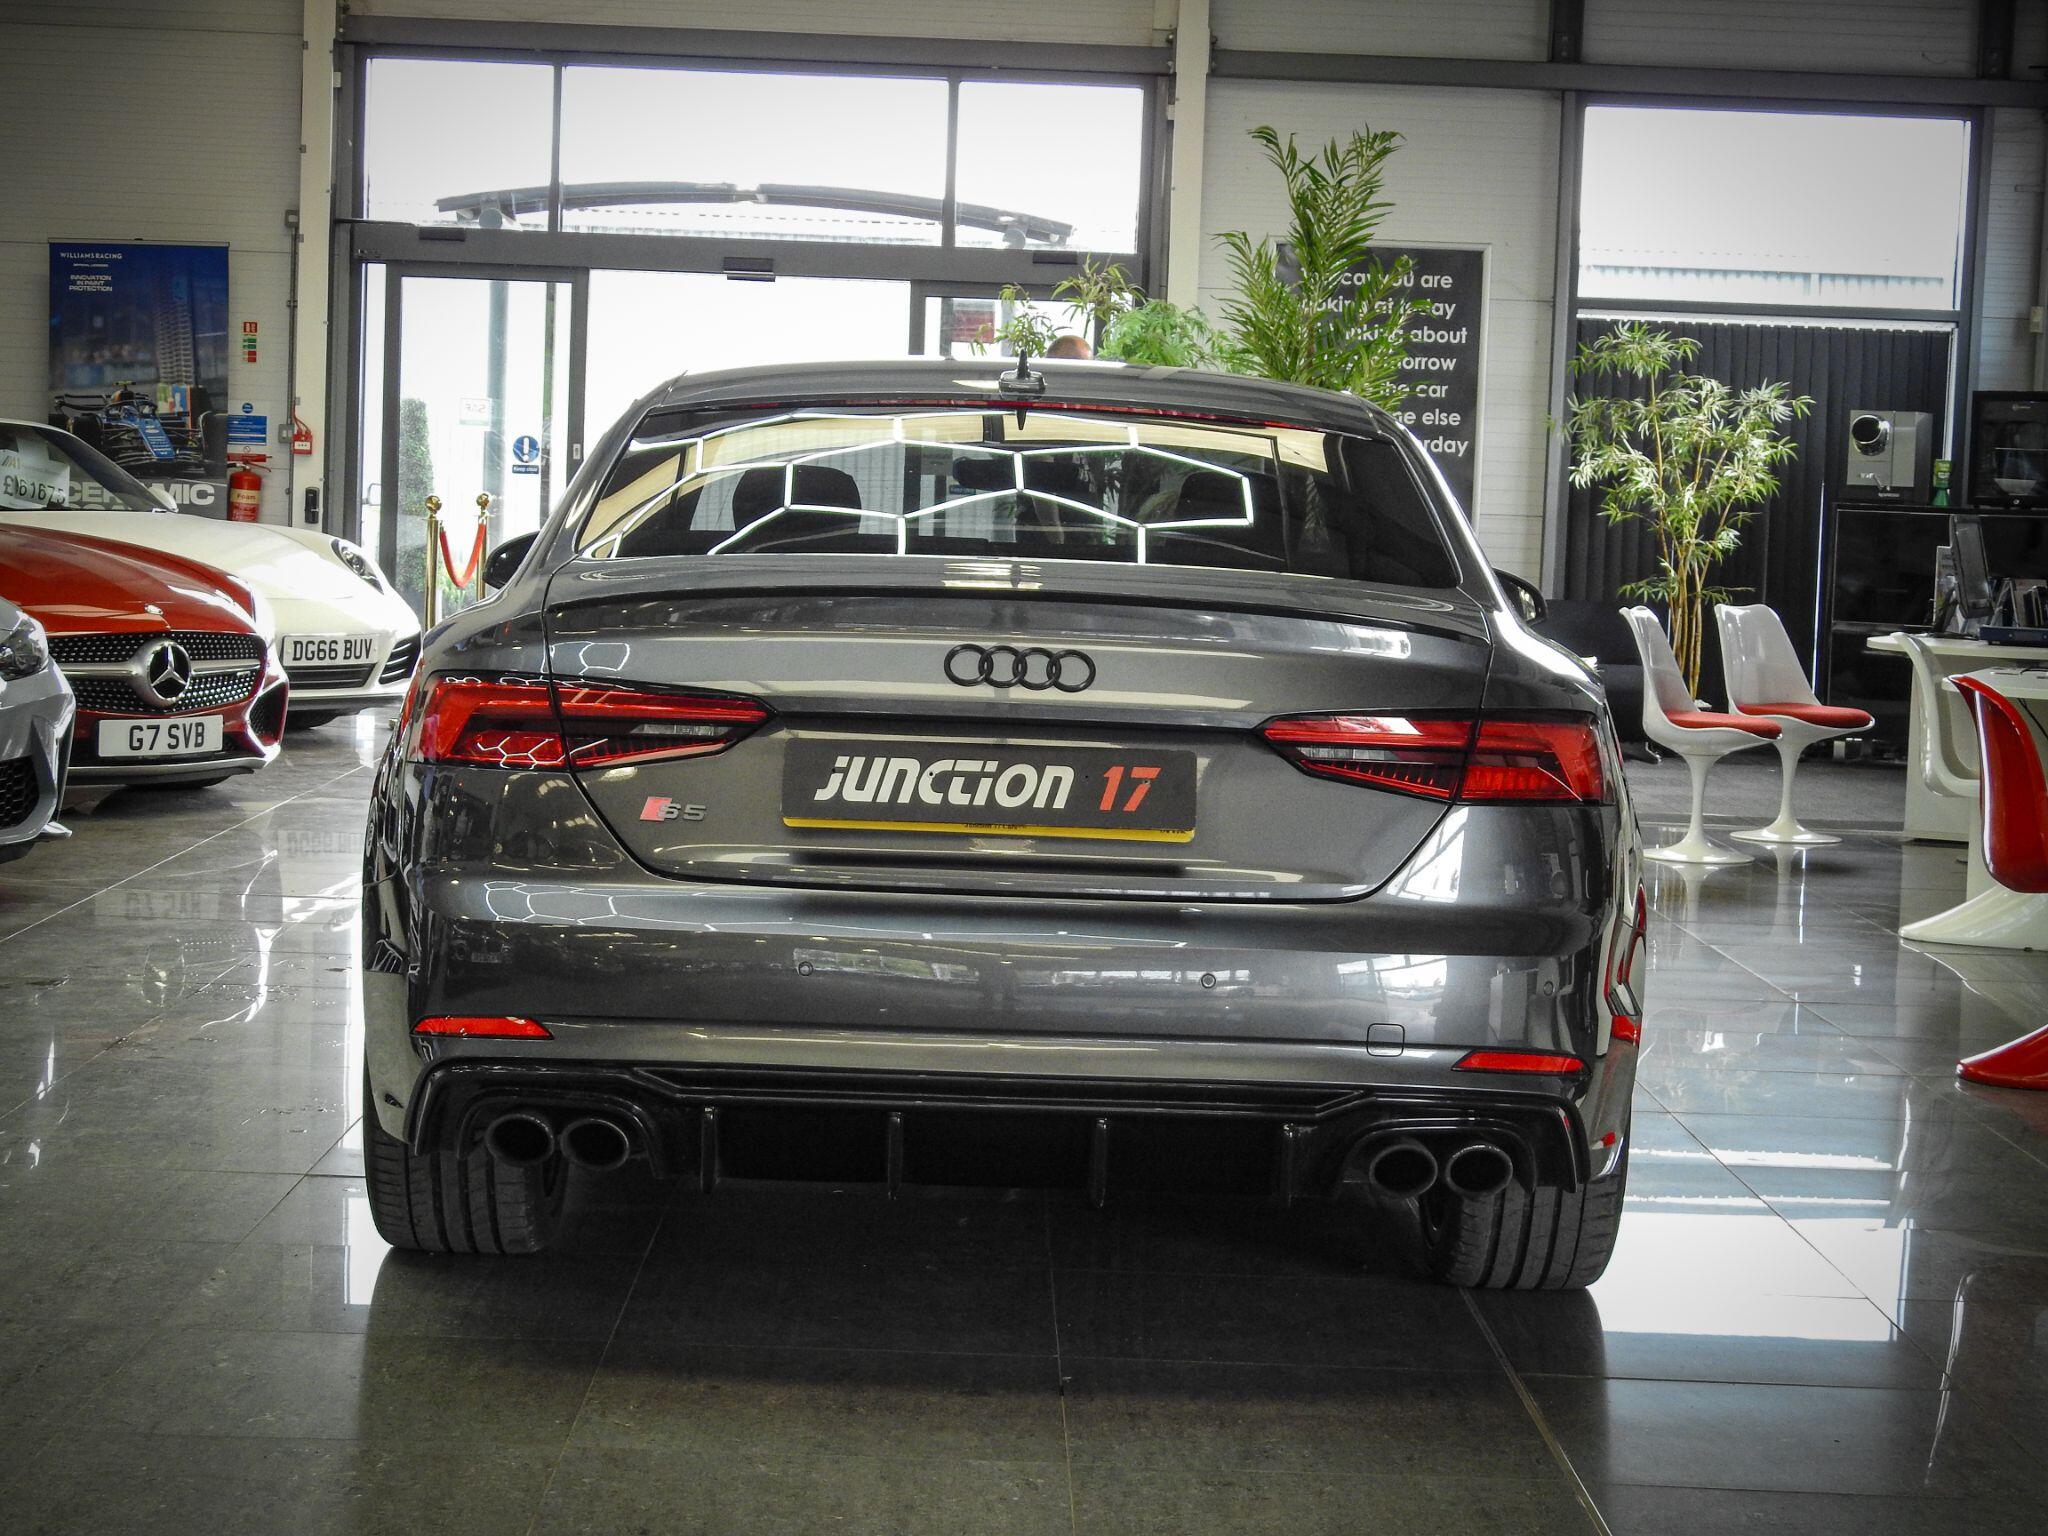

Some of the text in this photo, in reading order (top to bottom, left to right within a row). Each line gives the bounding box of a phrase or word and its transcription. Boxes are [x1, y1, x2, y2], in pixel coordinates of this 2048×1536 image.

[1420, 274, 1453, 288] are
[1410, 325, 1468, 344] about
[1398, 356, 1457, 371] orrow
[1416, 384, 1449, 398] car
[1422, 408, 1461, 426] else
[292, 638, 373, 661] DG66 BUV
[129, 721, 206, 751] G7 SVB
[1099, 765, 1162, 813] 17
